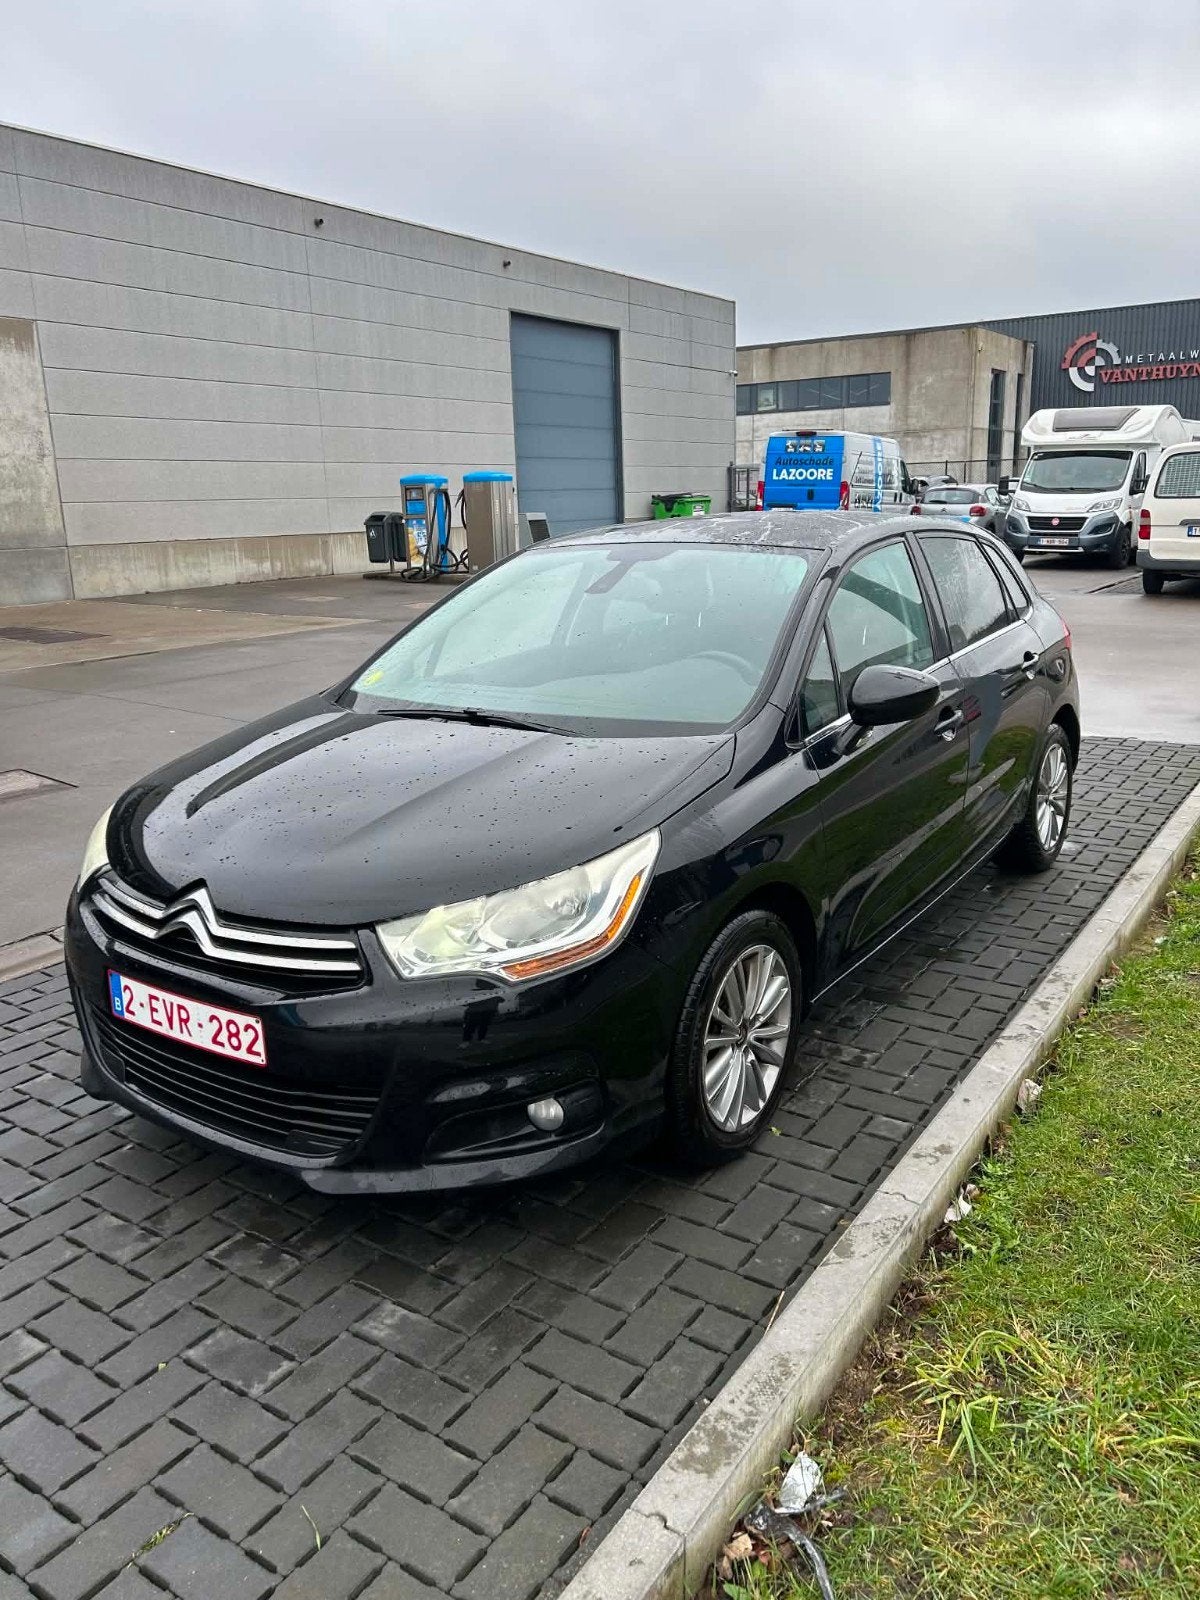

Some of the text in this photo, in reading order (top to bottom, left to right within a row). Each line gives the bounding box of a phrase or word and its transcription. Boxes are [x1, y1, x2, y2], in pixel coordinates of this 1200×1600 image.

[775, 456, 834, 466] Autoschade
[772, 468, 834, 480] LAZOORE
[115, 984, 262, 1058] B 2-EVR-282
